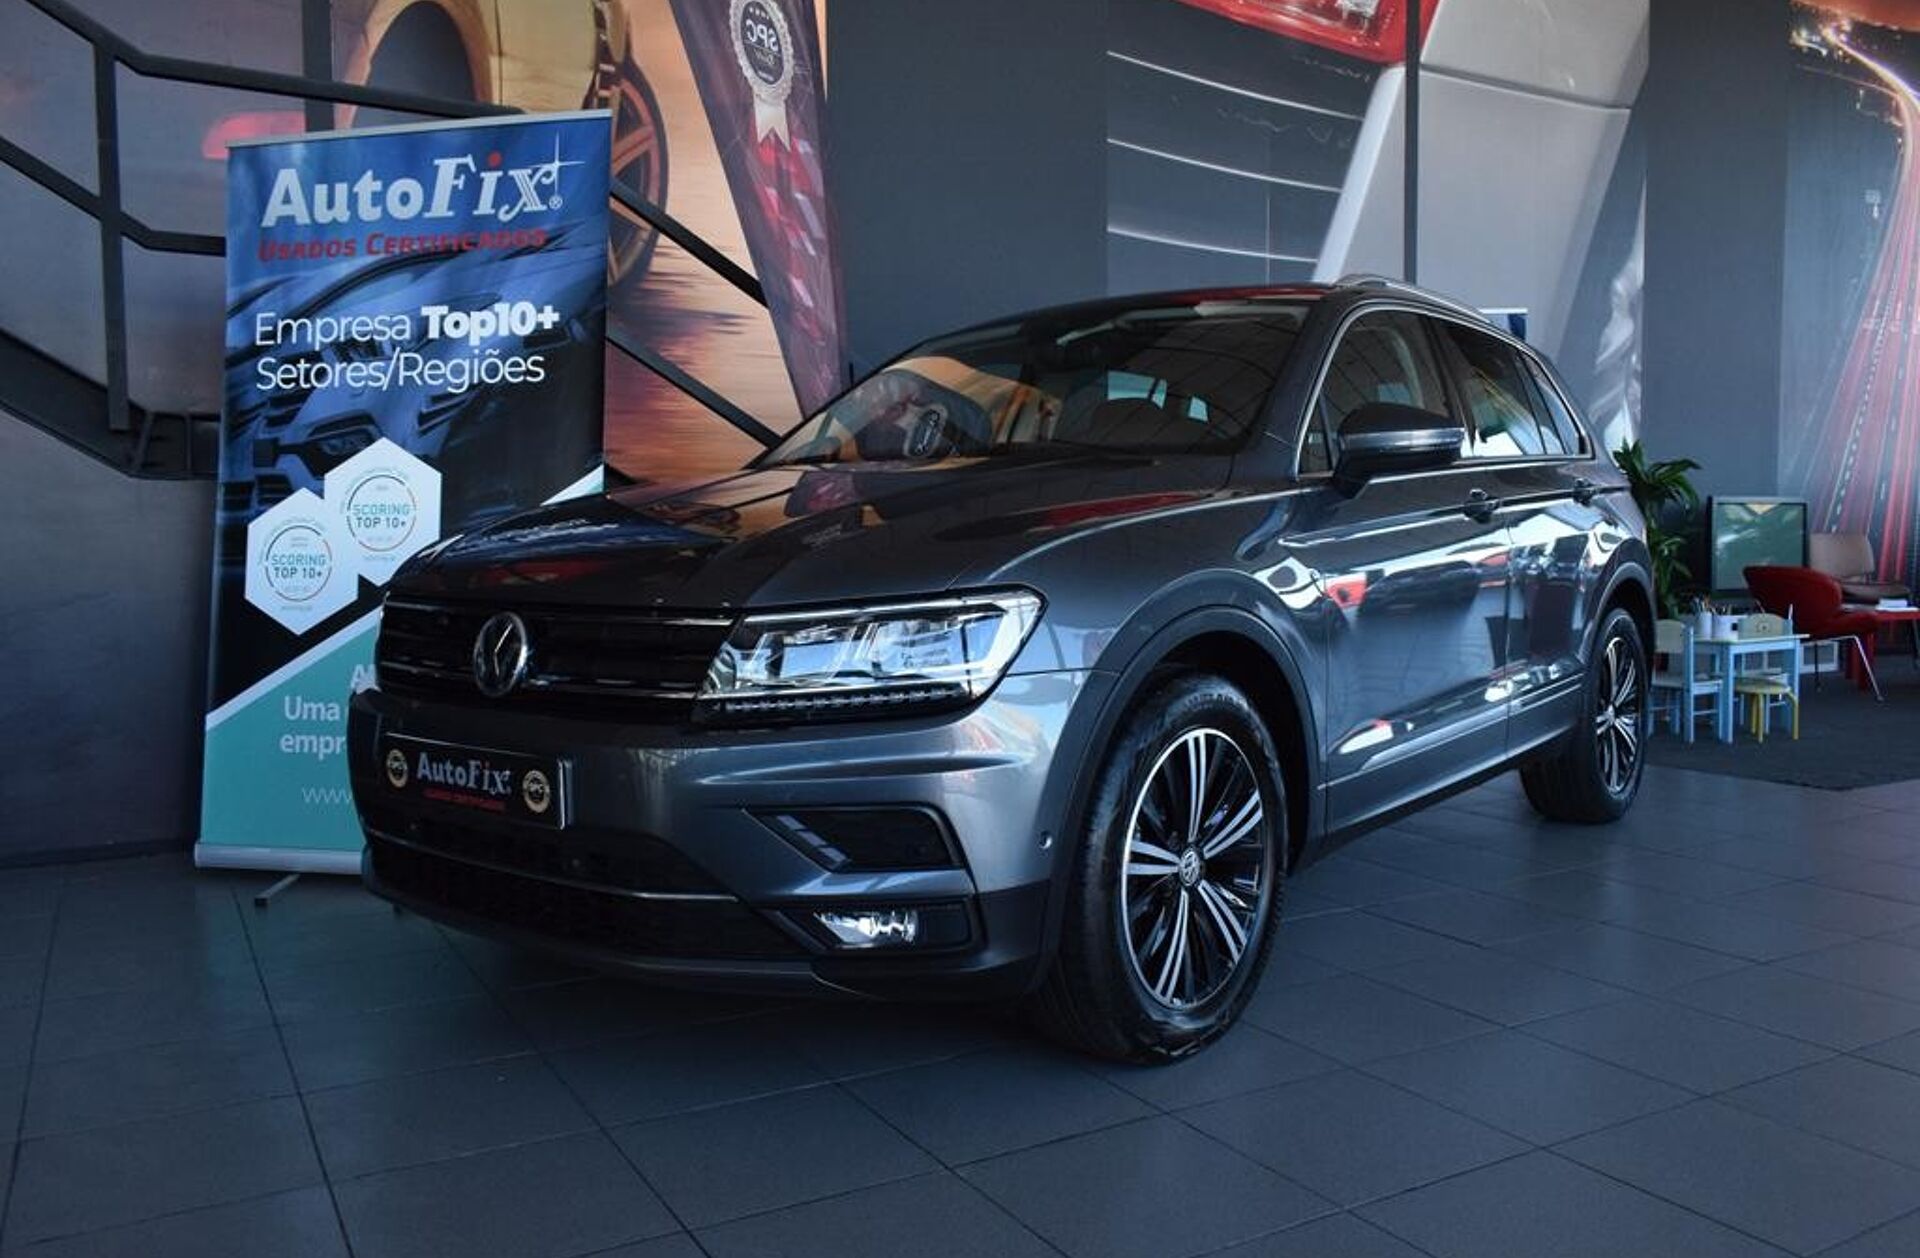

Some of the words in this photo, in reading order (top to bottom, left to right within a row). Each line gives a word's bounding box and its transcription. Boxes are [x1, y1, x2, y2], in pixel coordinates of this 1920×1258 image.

[261, 151, 562, 227] AutoFix
[255, 311, 411, 350] Empresa
[421, 301, 561, 345] Top10+
[256, 347, 545, 393] Setores/Regiões
[353, 504, 410, 515] SCORING
[356, 517, 381, 528] TOP
[271, 553, 327, 566] SCORING
[274, 567, 298, 579] TOP
[284, 697, 341, 721] Uma
[280, 734, 347, 760] empr
[416, 752, 512, 794] AutoFix
